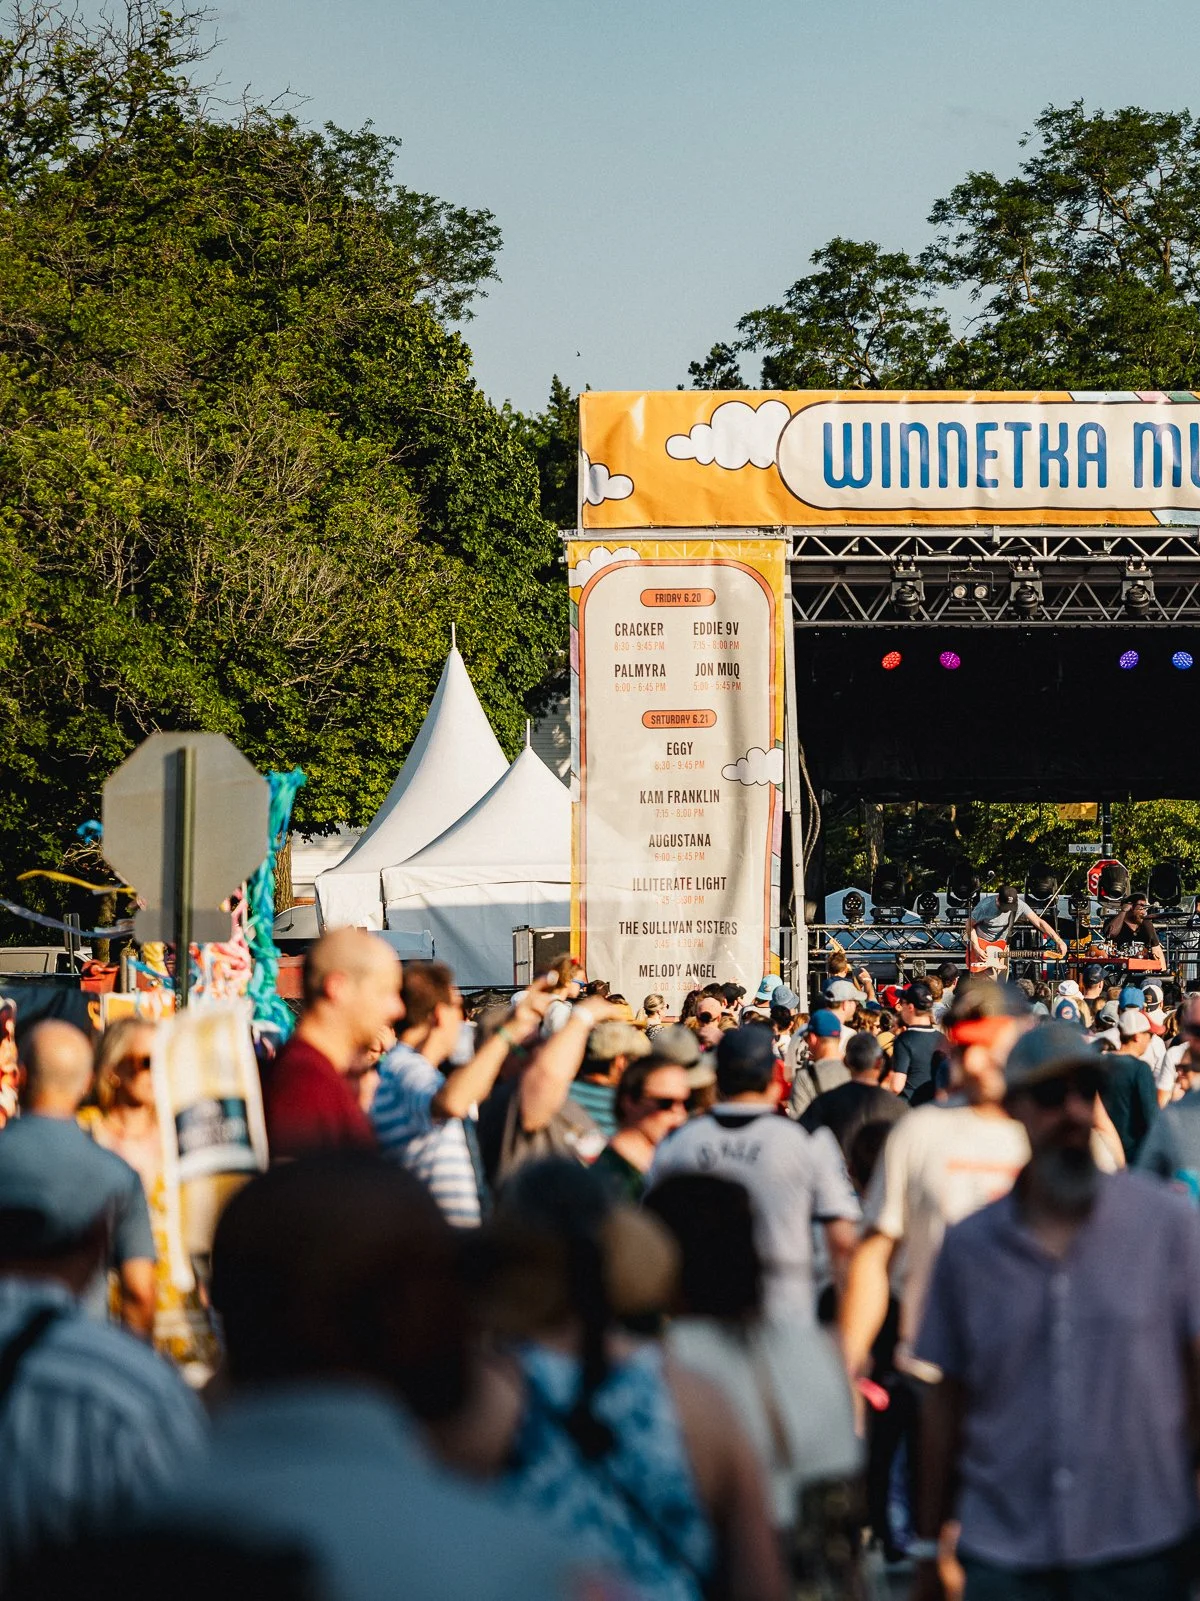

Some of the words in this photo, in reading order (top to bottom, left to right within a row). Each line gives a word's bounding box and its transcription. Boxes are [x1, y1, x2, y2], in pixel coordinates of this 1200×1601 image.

[823, 421, 1107, 489] WINNETKA
[655, 593, 682, 603] FRIDAY
[684, 592, 701, 603] 6.20
[614, 622, 664, 637] CRACKER
[693, 621, 723, 636] EDDIE
[725, 621, 739, 636] 9V
[655, 641, 665, 650] PM
[729, 640, 740, 650] PM
[614, 663, 667, 678] PALMYRA
[695, 662, 714, 677] JON
[717, 662, 740, 680] MUQ
[655, 682, 666, 692] PM
[731, 681, 742, 691] PM
[650, 714, 690, 725] SATURDAY
[692, 714, 709, 724] 6.21
[666, 741, 694, 756] EGGY
[694, 760, 705, 769] PM
[640, 790, 664, 804] KAM
[667, 789, 720, 804] FRANKLIN
[693, 807, 705, 817] PM
[648, 833, 712, 848] AUGUSTANA
[694, 851, 705, 861] PM
[632, 877, 693, 891] ILLITERATE
[696, 876, 727, 891] LIGHT
[694, 895, 705, 905] PM
[618, 921, 639, 935] THE
[642, 920, 693, 935] SULLIVAN
[696, 920, 738, 935] SISTERS
[693, 939, 705, 949] PM
[639, 964, 682, 978] MELODY
[685, 964, 717, 978] ANGEL
